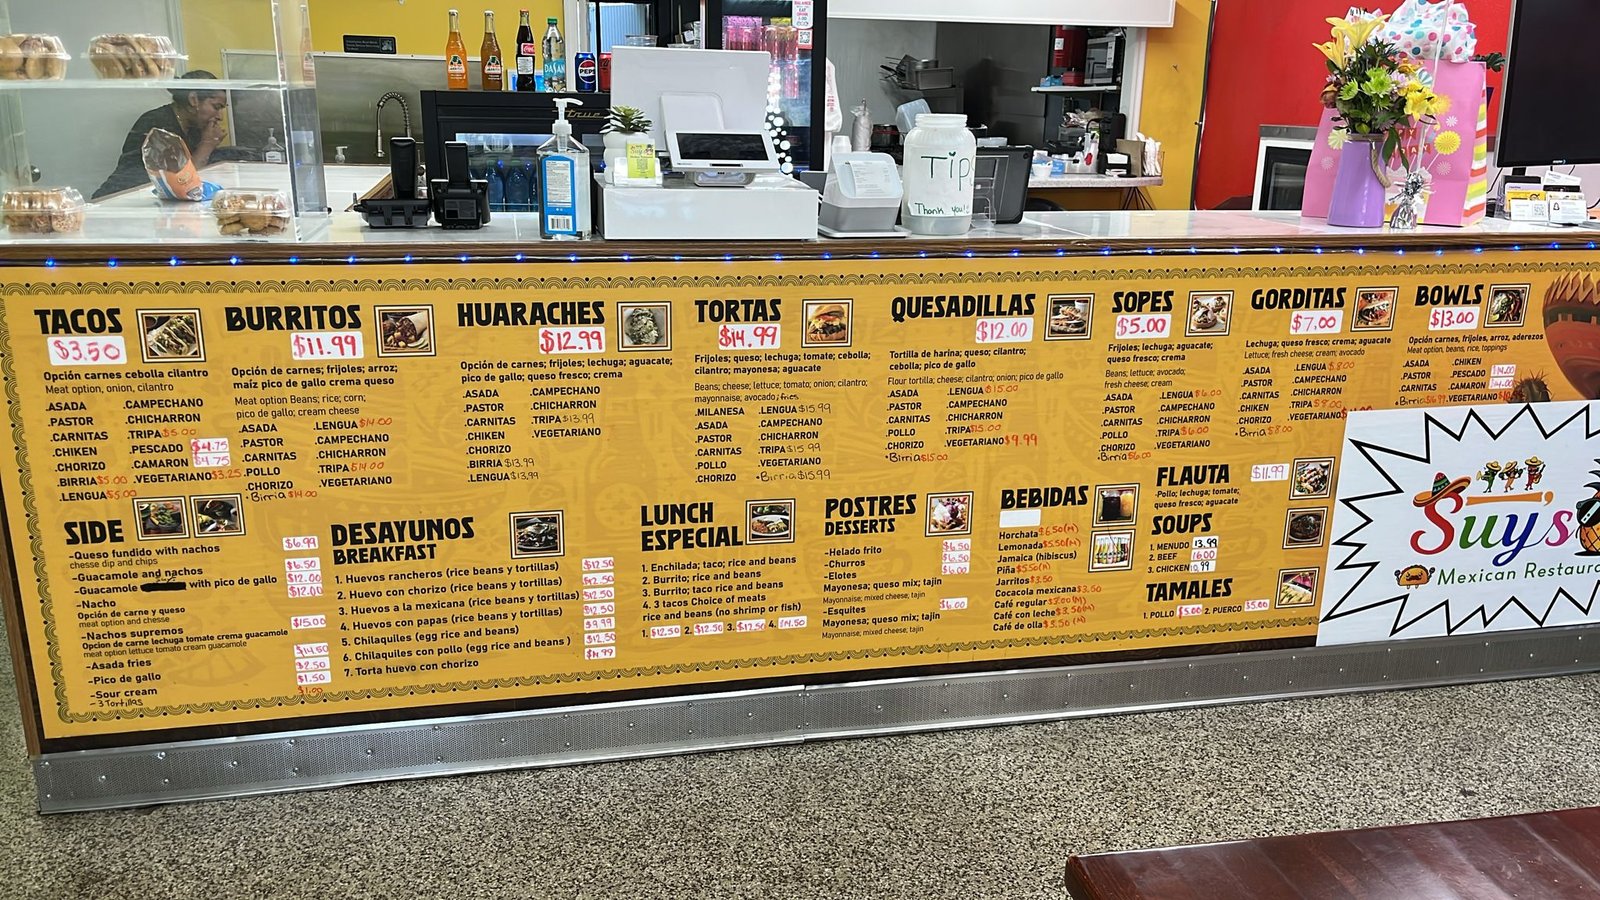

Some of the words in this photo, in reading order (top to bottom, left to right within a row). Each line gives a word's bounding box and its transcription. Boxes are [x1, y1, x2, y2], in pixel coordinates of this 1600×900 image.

[544, 62, 566, 74] DASAN
[915, 202, 944, 214] Thank
[1111, 290, 1174, 313] SOPES
[1250, 286, 1347, 310] GORDITAS
[1414, 283, 1484, 306] BOWLS
[456, 300, 605, 327] HUARACHES
[694, 298, 781, 323] TORTAS
[891, 293, 1036, 323] QUESADILLAS
[33, 307, 123, 335] TACOS
[224, 304, 362, 331] BURRITOS
[1430, 309, 1474, 328] $13.00
[976, 322, 1028, 342] $12.00
[1116, 317, 1166, 337] $5.00
[293, 334, 357, 358] $11.99
[540, 330, 603, 354] $12.99
[719, 325, 777, 349] $14.99
[1245, 339, 1279, 349] Lechuga;
[1280, 340, 1303, 348] queso
[1305, 338, 1330, 346] fresco;
[1358, 336, 1391, 346] aguacate
[1408, 334, 1433, 346] Opción
[1461, 334, 1488, 344] frijoles,
[1489, 334, 1510, 342] arroz,
[1511, 332, 1543, 341] aderezos
[53, 339, 121, 362] $3.50
[889, 349, 918, 359] Tortilla
[920, 349, 931, 358] de
[933, 348, 962, 357] harina;
[964, 349, 991, 358] queso;
[992, 347, 1026, 356] cilantro;
[1108, 343, 1140, 353] Frijoles;
[1141, 342, 1174, 352] lechuga;
[1176, 341, 1213, 351] aguacate;
[460, 359, 494, 372] Opción
[496, 360, 508, 369] de
[510, 361, 546, 369] carnes;
[548, 358, 585, 369] frijoles;
[587, 357, 626, 368] lechuga;
[628, 356, 672, 367] aguacate;
[694, 353, 731, 365] Frijoles;
[733, 354, 762, 364] queso;
[764, 352, 801, 362] lechuga;
[802, 351, 835, 361] tomate;
[837, 350, 871, 359] cebolla;
[889, 361, 922, 370] cebolla;
[923, 360, 941, 371] pico
[942, 360, 953, 369] de
[955, 359, 976, 370] gallo
[43, 369, 81, 383] Opción
[84, 371, 122, 380] carnes
[124, 369, 164, 379] cebolla
[167, 368, 209, 378] cilantro
[231, 365, 267, 378] Opción
[270, 365, 283, 375] de
[285, 366, 324, 375] carnes;
[326, 364, 365, 375] frijoles;
[367, 364, 398, 373] arroz;
[461, 373, 481, 384] pico
[483, 372, 496, 382] de
[498, 372, 524, 383] gallo;
[527, 373, 556, 382] queso
[558, 370, 590, 380] fresco;
[593, 371, 622, 379] crema
[694, 365, 731, 375] cilantro;
[732, 366, 780, 375] mayonesa;
[782, 363, 821, 374] aguacate
[44, 384, 69, 394] Meat
[71, 384, 104, 395] option,
[105, 384, 135, 393] onion,
[136, 382, 174, 392] cilantro
[232, 378, 258, 389] maíz
[260, 378, 283, 390] pico
[285, 378, 298, 387] de
[300, 377, 326, 389] gallo
[328, 378, 361, 386] crema
[363, 377, 394, 387] queso
[1104, 380, 1122, 388] fresh
[1123, 379, 1149, 388] cheese;
[1150, 379, 1172, 387] cream
[1156, 463, 1229, 487] FLAUTA
[1251, 464, 1285, 480] $11.99
[825, 493, 917, 519] POSTRES
[1000, 485, 1089, 510] BEBIDAS
[640, 501, 713, 527] LUNCH
[63, 519, 124, 545] SIDE
[330, 516, 475, 547] DESAYUNOS
[824, 517, 895, 536] DESSERTS
[1151, 512, 1212, 535] SOUPS
[285, 537, 317, 549] $6.99
[641, 526, 744, 552] ESPECIAL
[1150, 543, 1154, 551] 1.
[1156, 541, 1189, 550] MENUDO
[1194, 538, 1219, 549] 13.99
[111, 547, 152, 558] fundido
[154, 545, 178, 555] with
[181, 544, 220, 554] nachos
[332, 543, 437, 565] BREAKFAST
[863, 545, 882, 554] frito
[996, 553, 1033, 563] Jamaica
[1035, 549, 1077, 562] (hibiscus)
[1148, 553, 1155, 561] 2.
[1156, 552, 1178, 561] BEEF
[334, 575, 343, 584] 1.
[345, 574, 385, 584] Huevos
[388, 570, 443, 581] rancheros
[445, 567, 470, 578] (rice
[472, 566, 504, 575] beans
[506, 566, 512, 575] y
[515, 560, 559, 572] tortillas)
[641, 563, 648, 572] 1.
[650, 560, 700, 572] Enchilada;
[702, 560, 725, 569] taco;
[727, 558, 746, 567] rice
[748, 556, 765, 566] and
[768, 556, 796, 565] beans
[288, 573, 321, 583] $12.00
[642, 575, 650, 585] 2.
[653, 574, 689, 584] Burrito;
[692, 572, 710, 582] rice
[712, 570, 730, 580] and
[733, 570, 761, 579] beans
[1437, 568, 1517, 586] Mexican
[1145, 577, 1233, 602] TAMALES
[1212, 604, 1242, 614] PUERCO
[343, 668, 353, 677] 7.
[354, 666, 382, 676] Torta
[385, 664, 417, 674] huevo
[419, 663, 438, 671] con
[440, 658, 479, 669] chorizo
